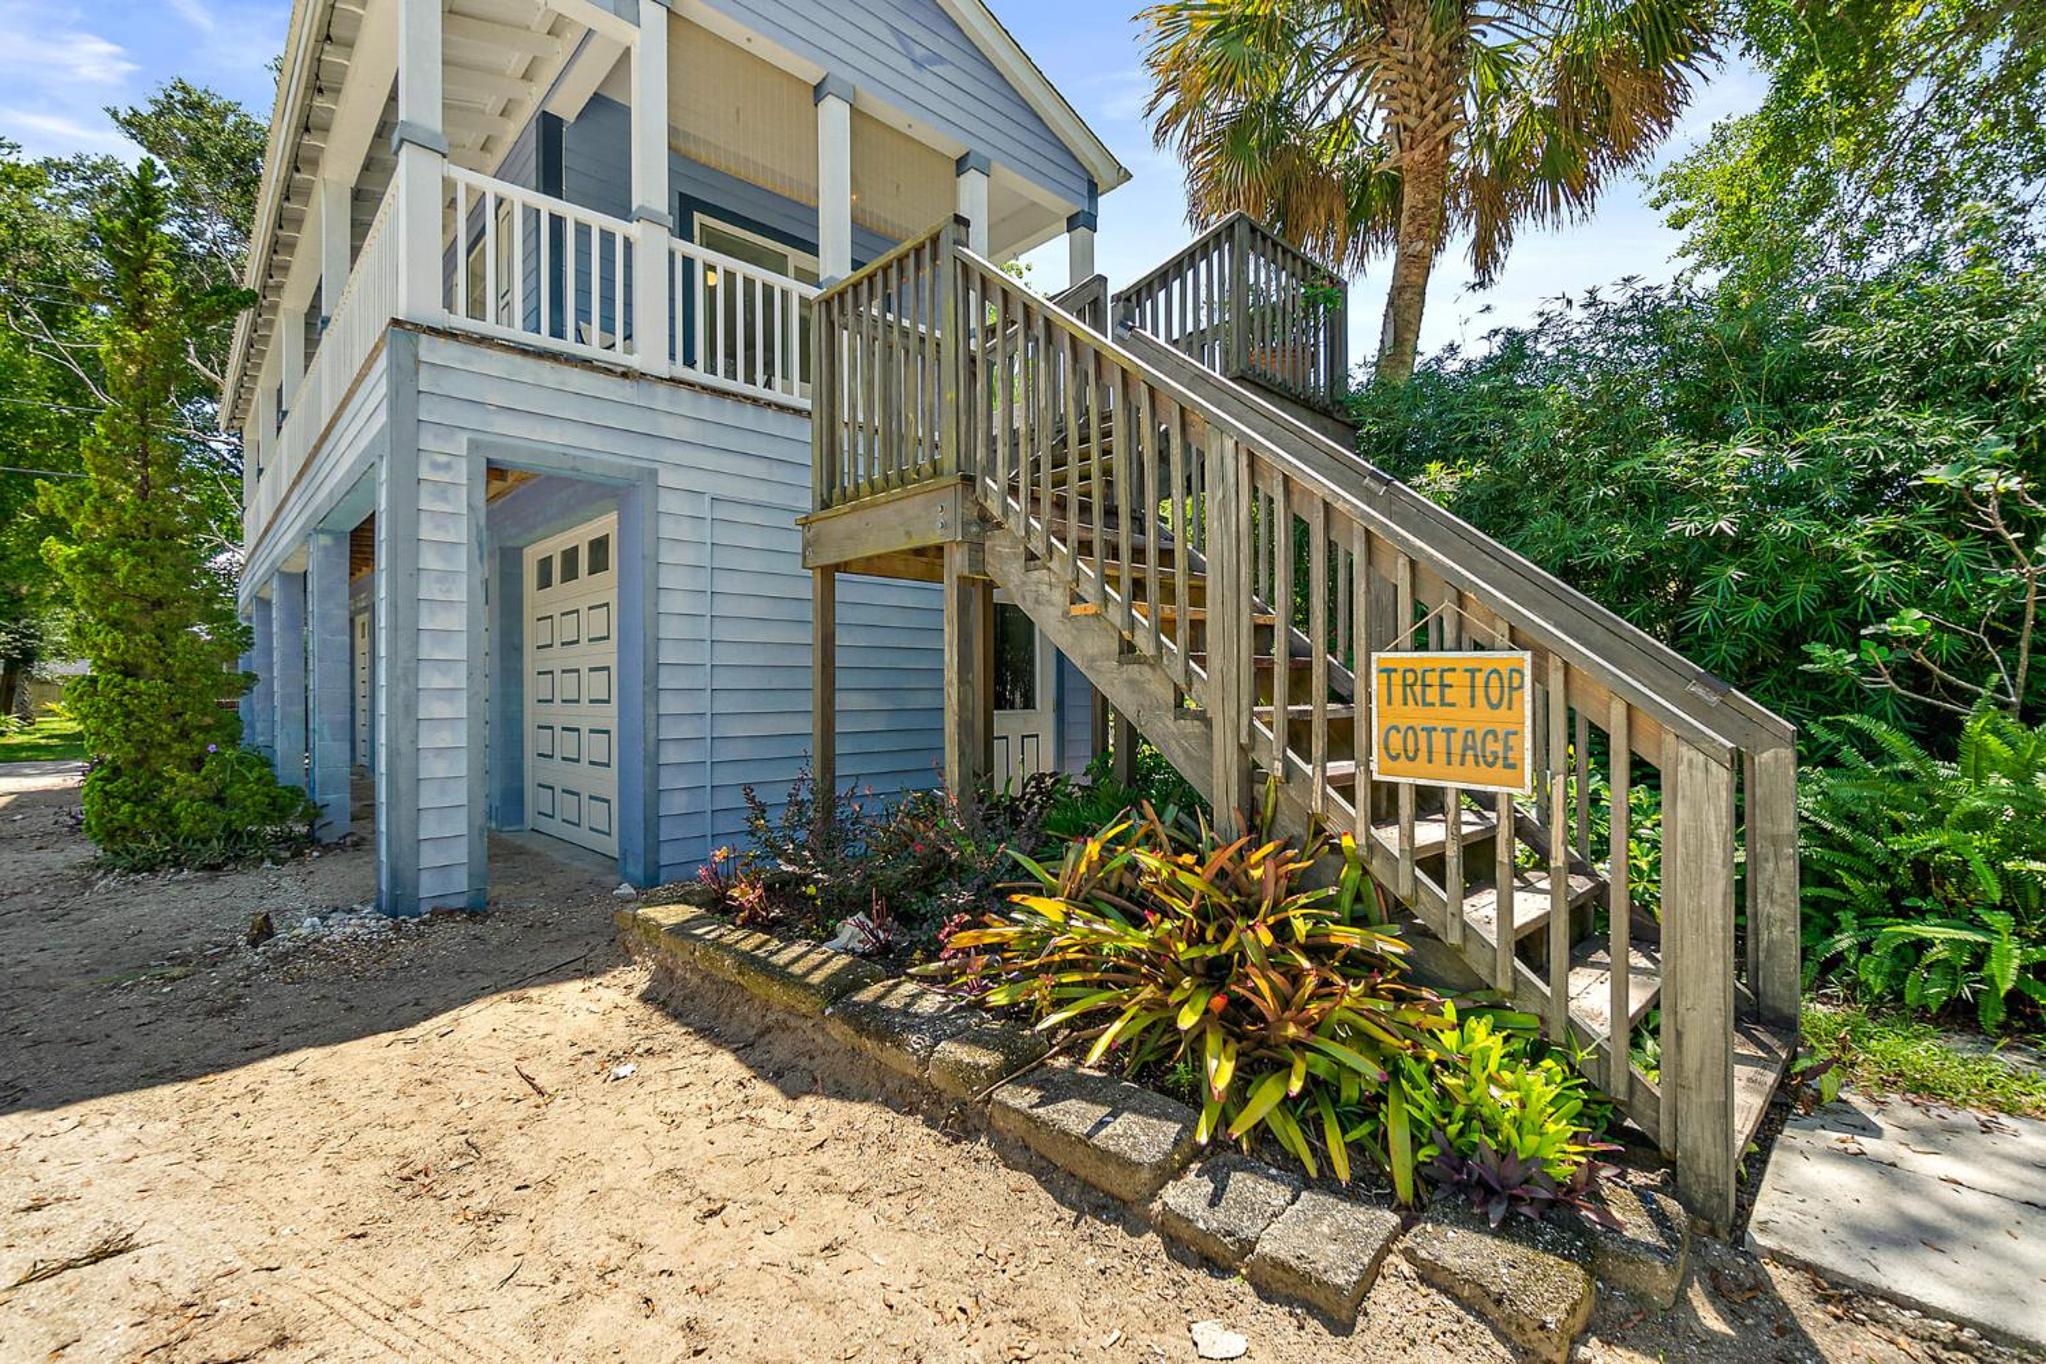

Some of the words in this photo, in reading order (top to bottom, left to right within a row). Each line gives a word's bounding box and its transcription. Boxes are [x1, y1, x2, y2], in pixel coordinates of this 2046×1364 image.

[1379, 667, 1457, 708] TREE
[1463, 667, 1525, 711] TOP
[1382, 725, 1519, 770] COTTAGE
